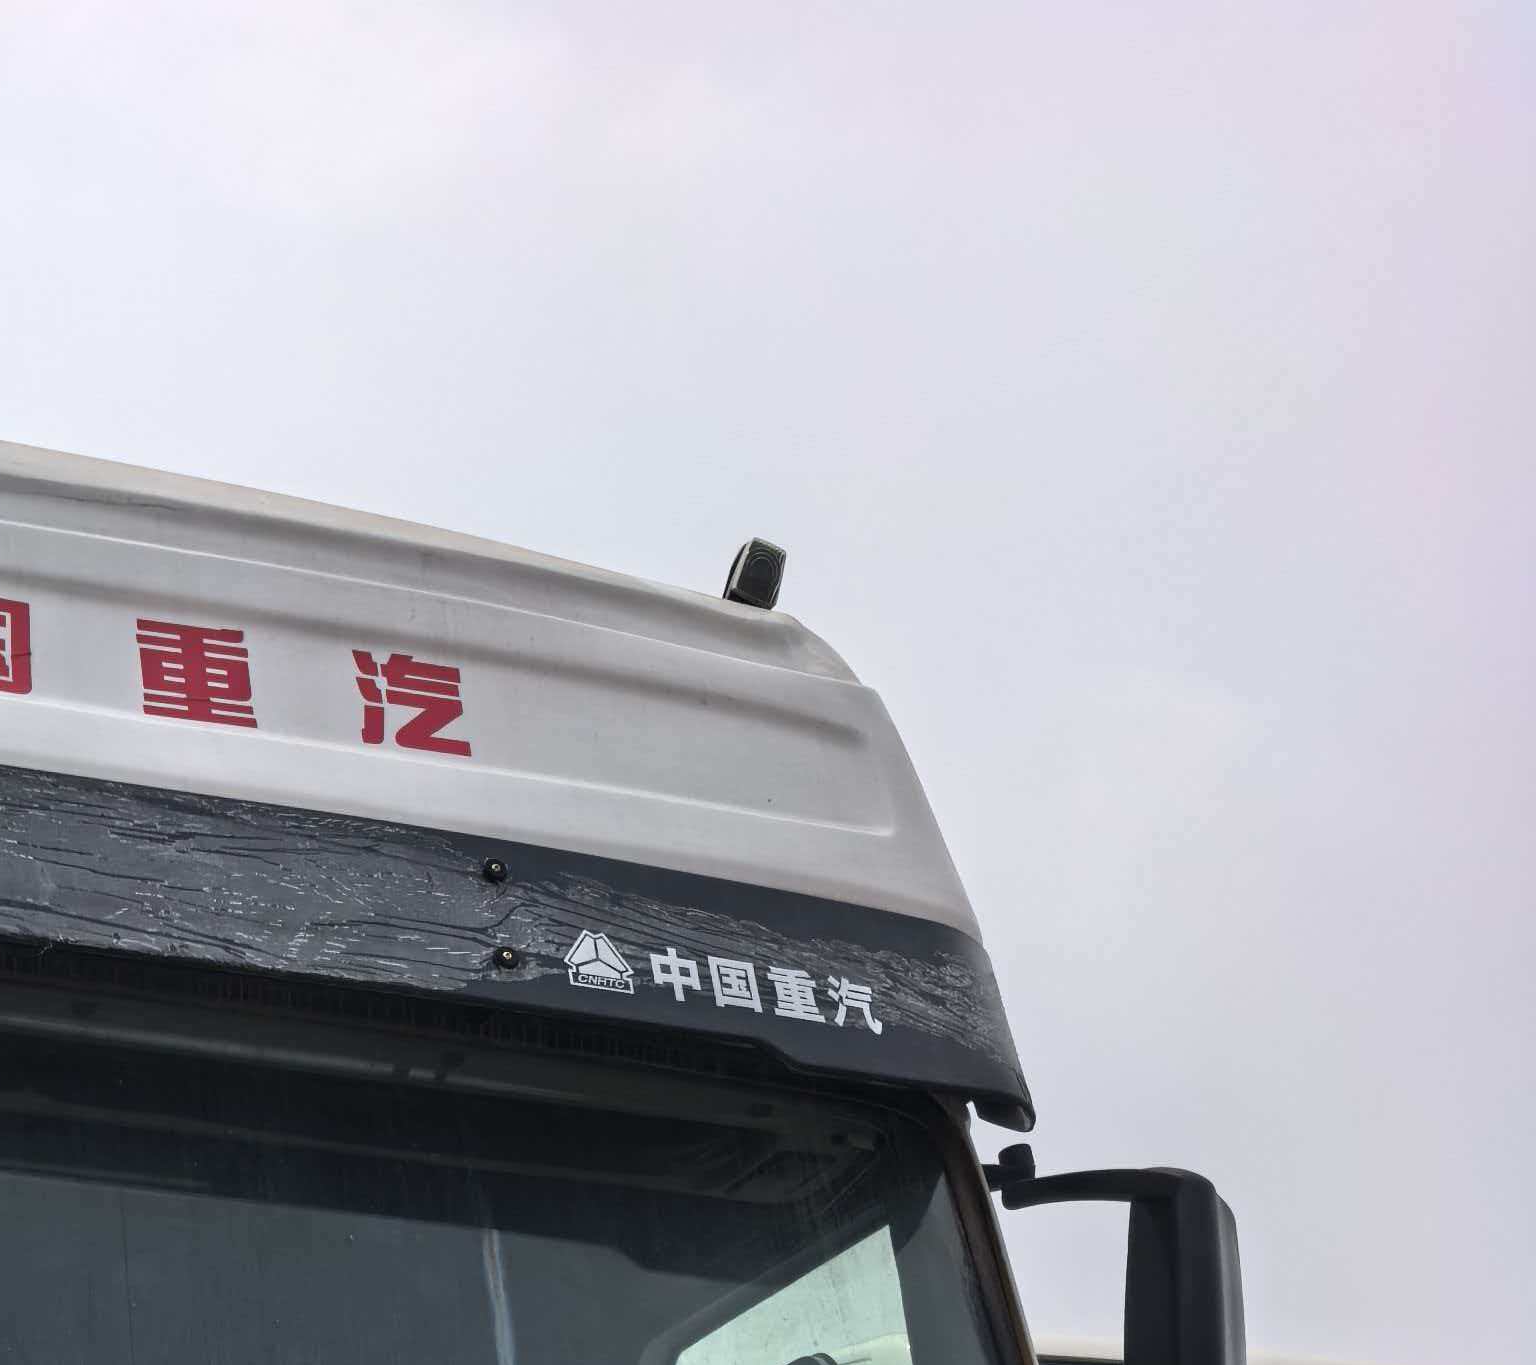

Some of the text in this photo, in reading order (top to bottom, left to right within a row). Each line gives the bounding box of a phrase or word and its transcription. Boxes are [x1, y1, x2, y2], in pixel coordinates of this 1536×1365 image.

[578, 974, 625, 989] CNHTC
[649, 947, 884, 1036] 中国重汽
